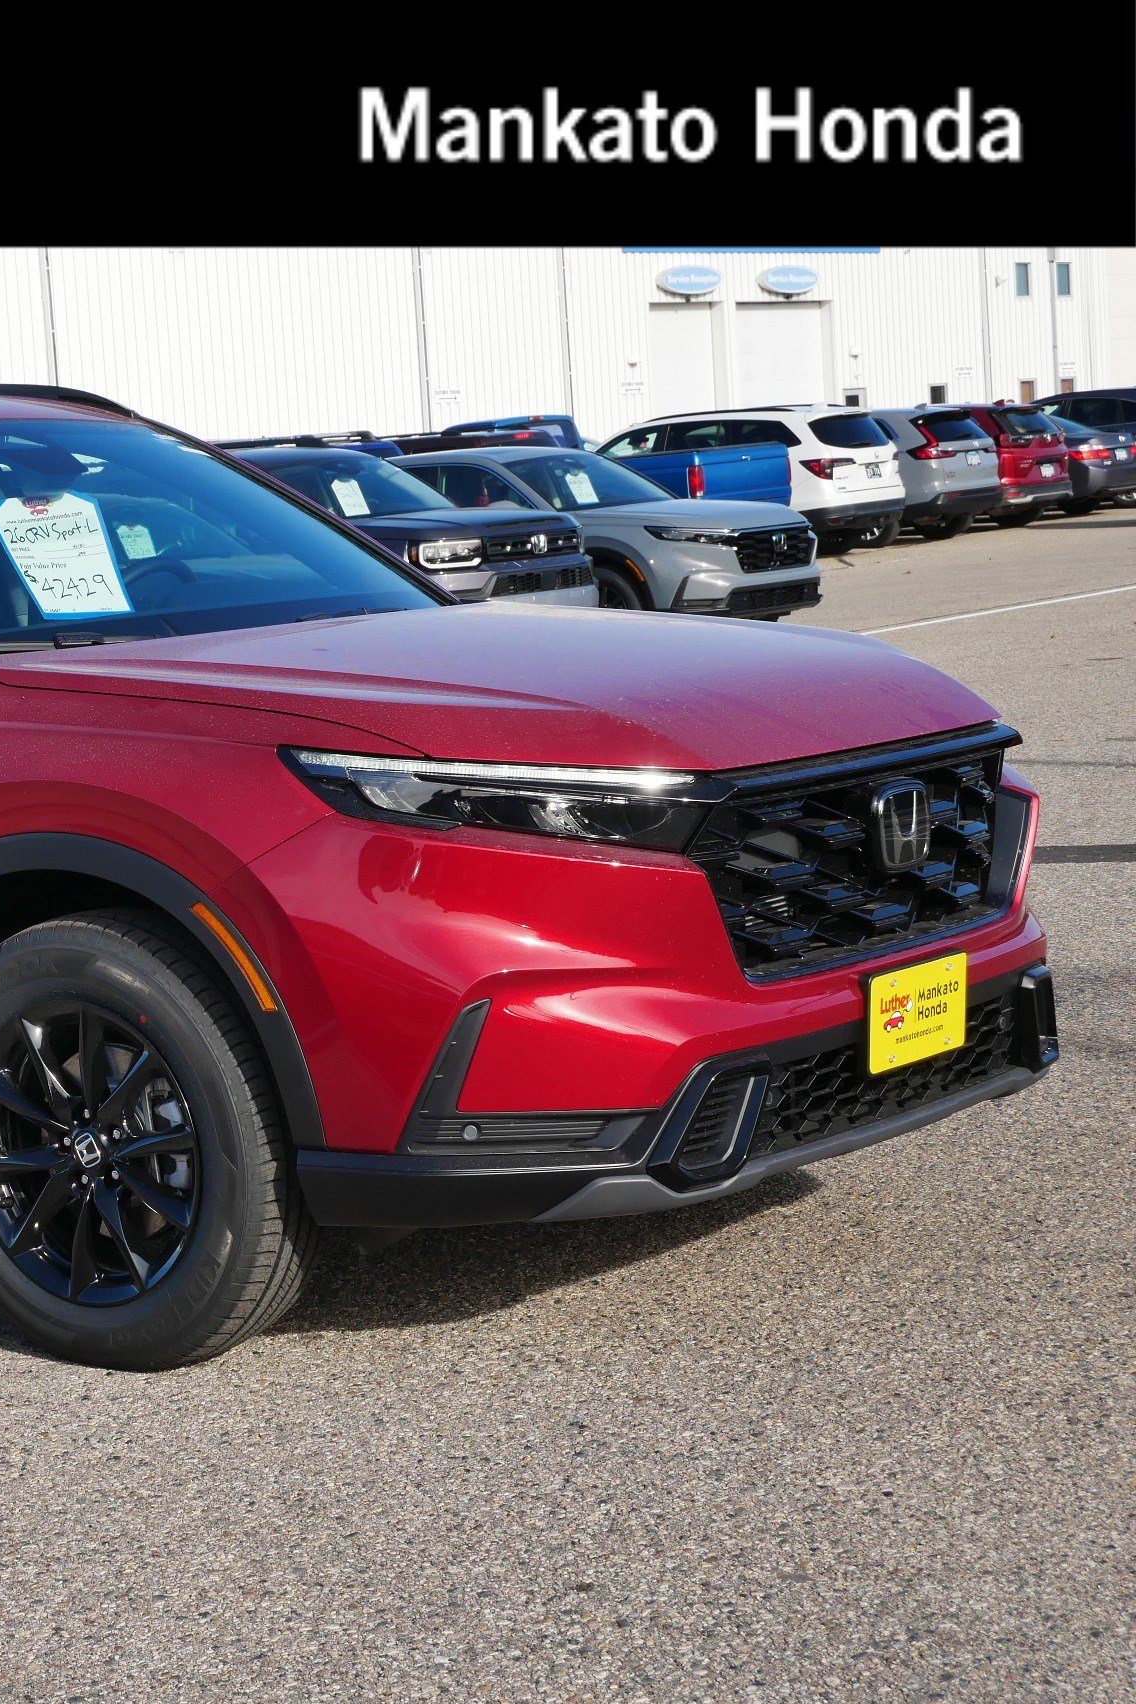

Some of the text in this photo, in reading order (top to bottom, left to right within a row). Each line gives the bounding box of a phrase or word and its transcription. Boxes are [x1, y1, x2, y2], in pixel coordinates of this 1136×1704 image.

[917, 979, 959, 1003] Mankato
[879, 993, 911, 1015] Luther
[917, 1000, 948, 1021] Honda
[895, 1023, 944, 1045] mankatohonda.com
